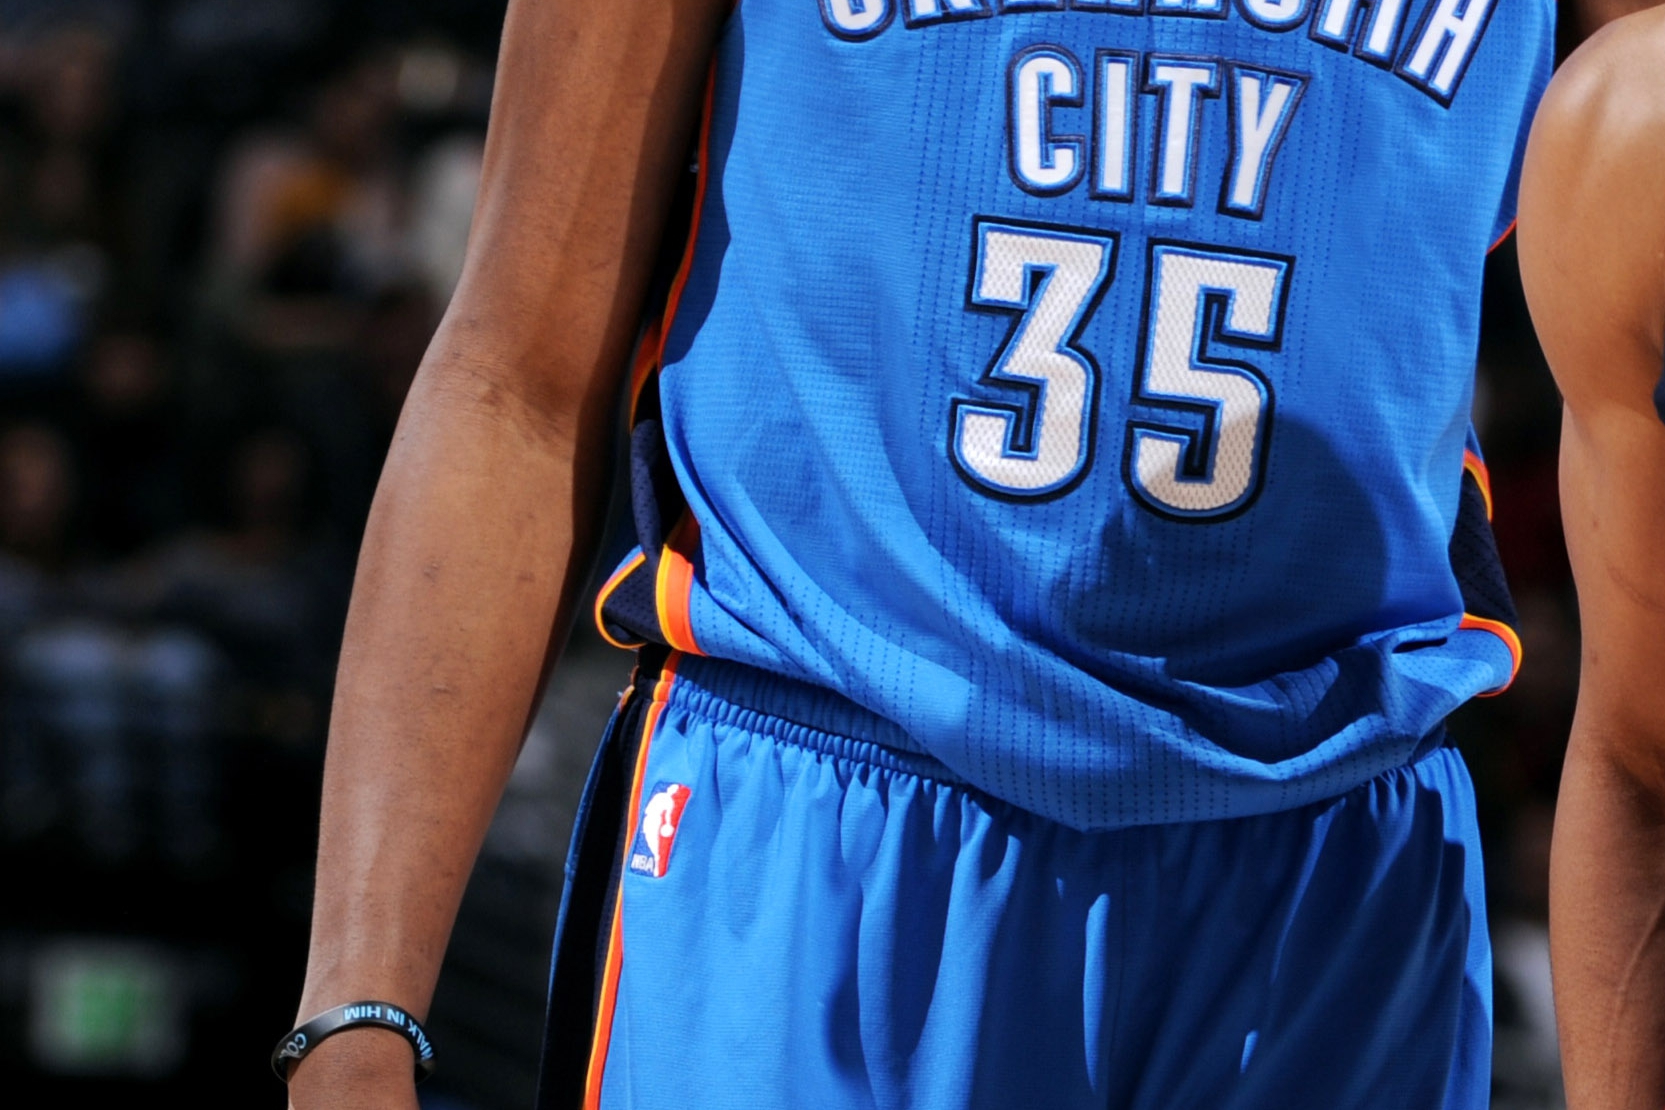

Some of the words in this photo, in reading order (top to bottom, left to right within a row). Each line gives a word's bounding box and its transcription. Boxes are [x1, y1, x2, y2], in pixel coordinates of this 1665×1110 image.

[1006, 44, 1310, 220] CITY
[947, 214, 1295, 523] 35
[631, 854, 654, 872] NBA
[344, 1005, 381, 1021] HIM
[387, 1008, 405, 1026] IN
